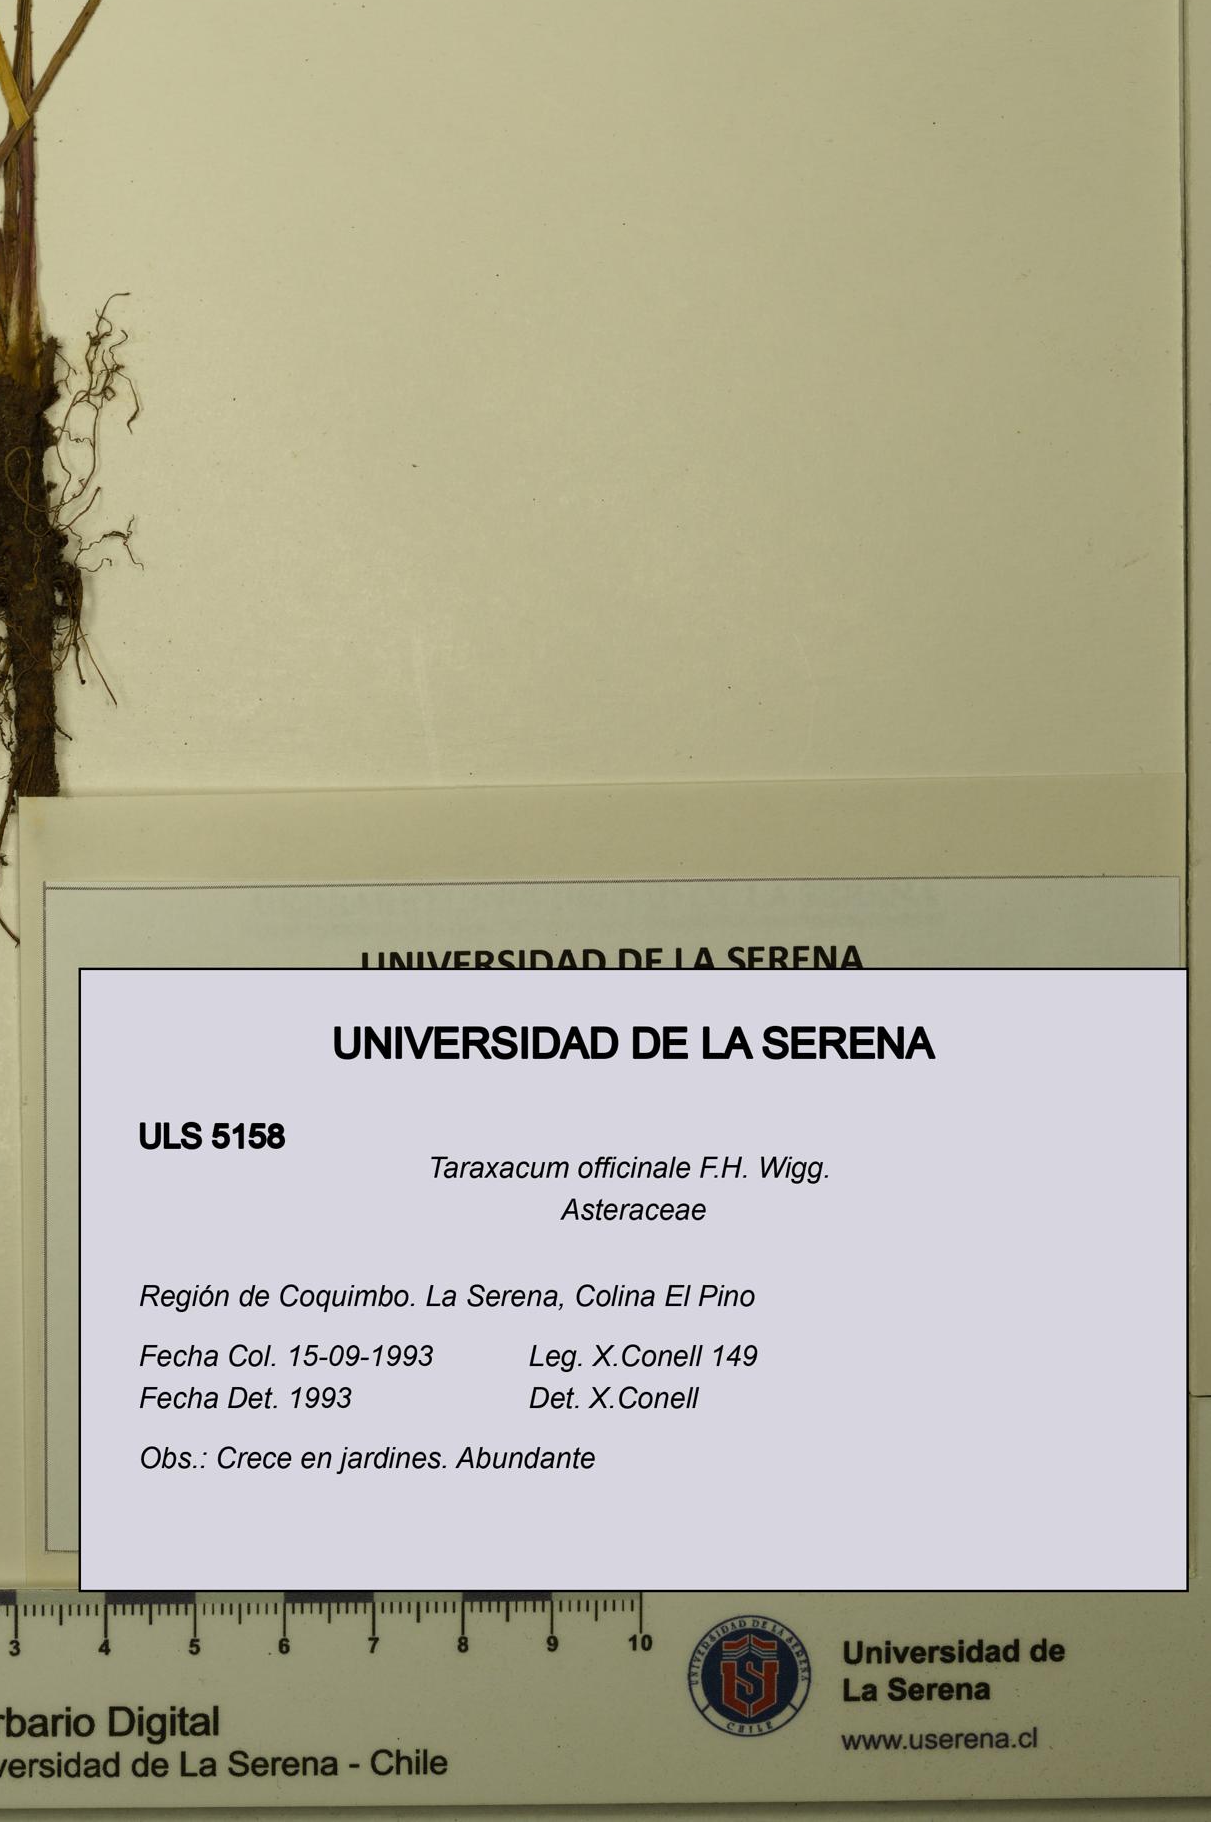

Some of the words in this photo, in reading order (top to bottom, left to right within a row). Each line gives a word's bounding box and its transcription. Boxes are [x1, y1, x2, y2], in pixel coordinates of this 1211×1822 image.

[8, 1640, 21, 1656] 3
[97, 1639, 112, 1656] 4
[188, 1639, 201, 1655] 5
[278, 1638, 291, 1654] 6
[367, 1637, 380, 1654] 7
[457, 1636, 469, 1653] 8
[546, 1635, 559, 1653] 9
[628, 1635, 653, 1652] 10
[843, 1638, 1020, 1666] Universidad
[1029, 1637, 1066, 1663] de
[843, 1677, 878, 1703] La
[887, 1675, 991, 1703] Serena
[108, 1705, 220, 1745] Digital
[726, 1721, 774, 1734] CHILE
[841, 1726, 1038, 1752] www.userena.cl
[131, 1750, 170, 1779] de
[180, 1750, 217, 1778] La
[227, 1749, 339, 1778] Serena
[370, 1747, 449, 1777] Chile
